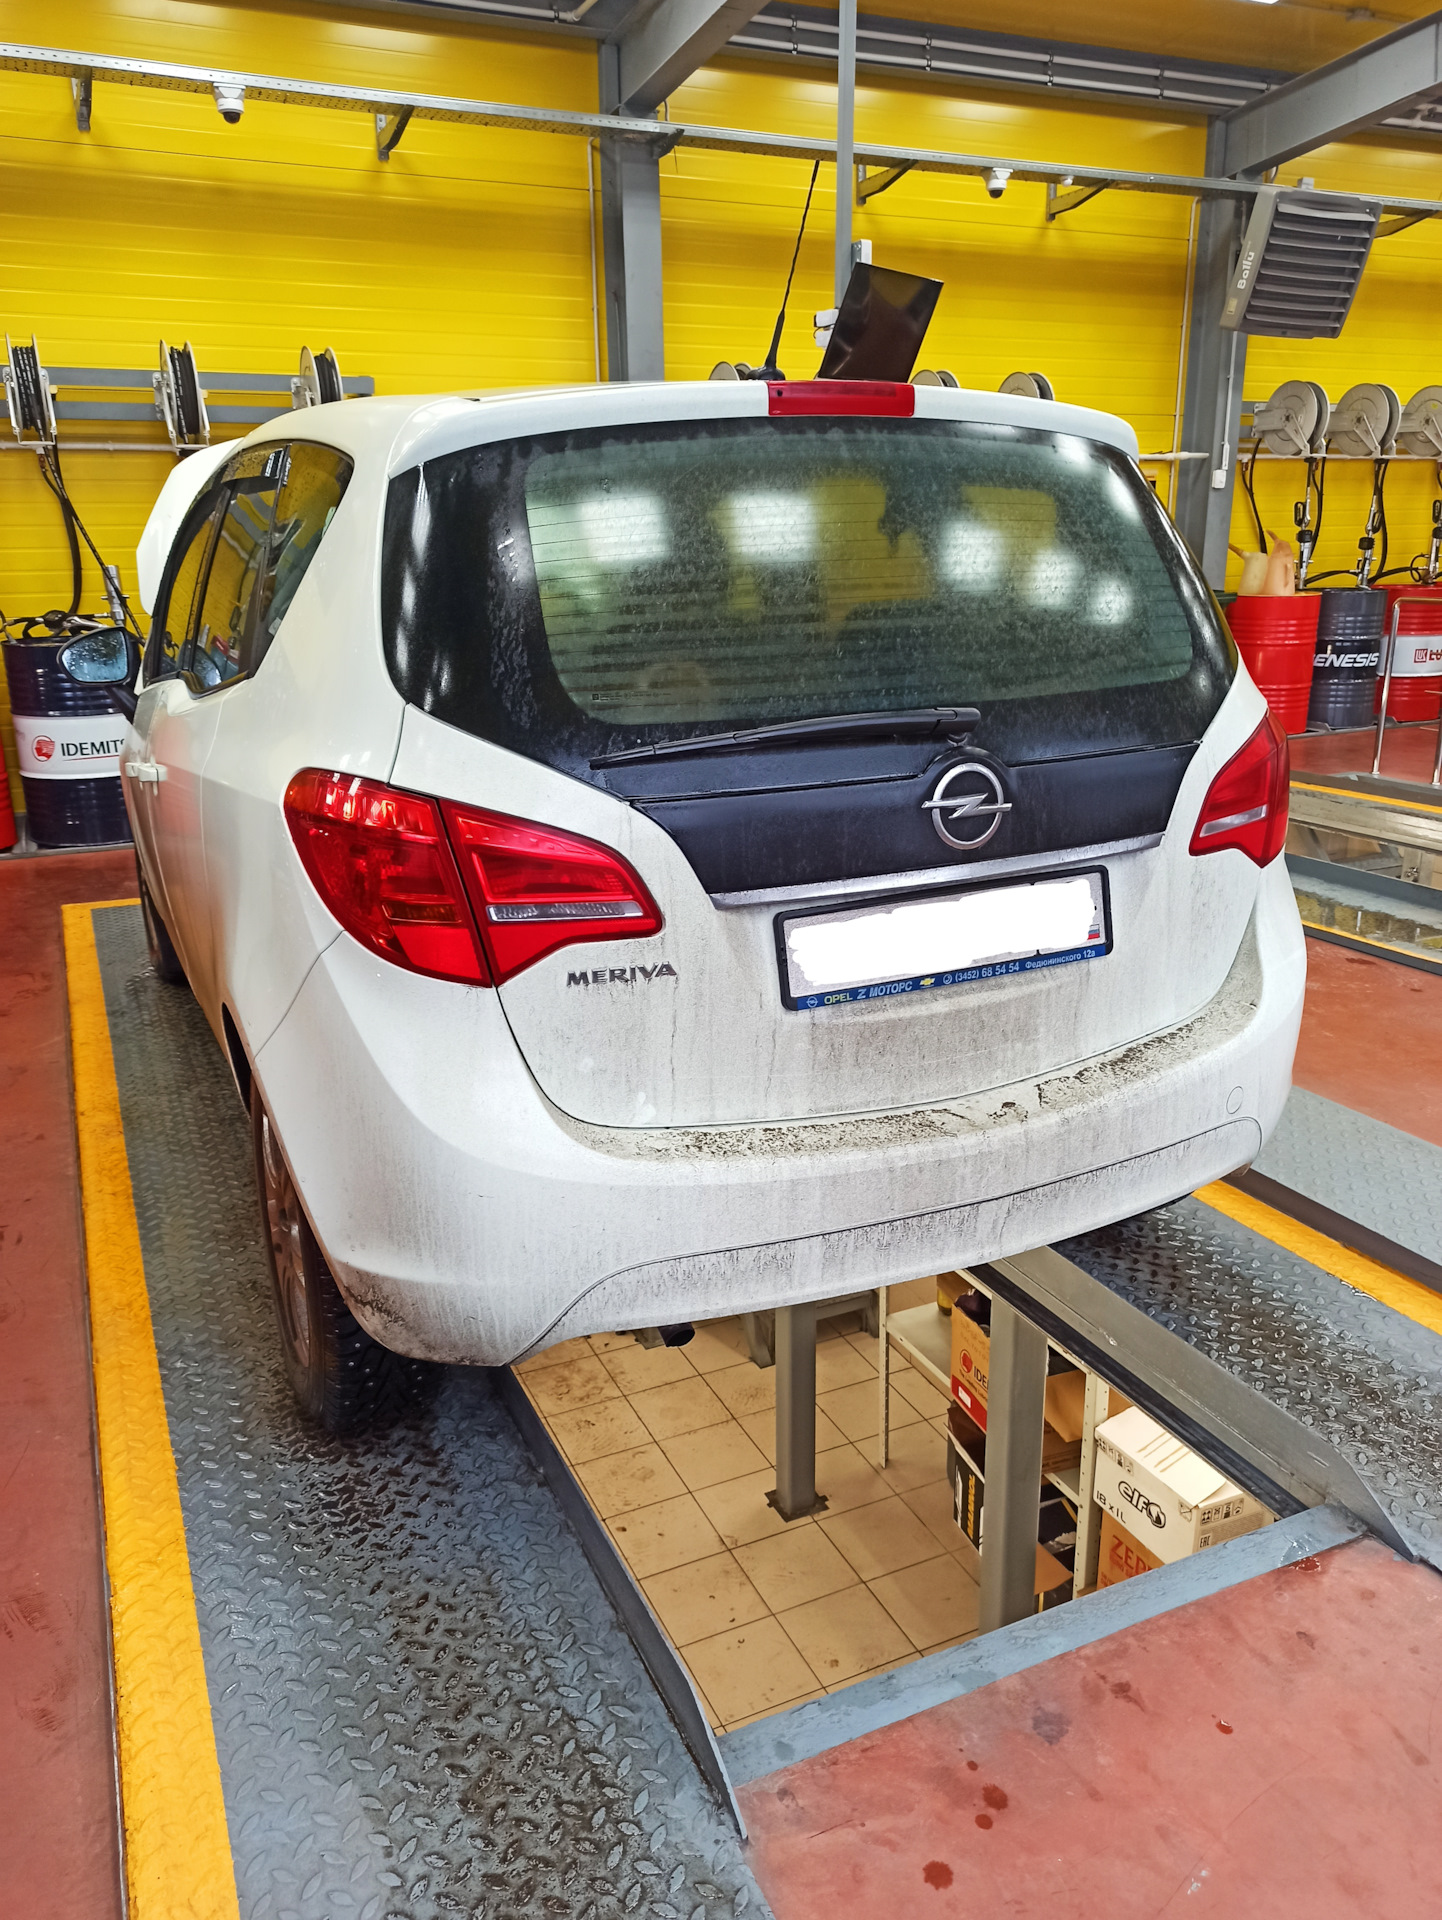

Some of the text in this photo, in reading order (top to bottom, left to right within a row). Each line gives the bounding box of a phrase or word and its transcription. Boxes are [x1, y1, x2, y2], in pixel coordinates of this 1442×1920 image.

[1236, 251, 1255, 289] Ballu
[1313, 652, 1379, 667] ENESIS
[60, 738, 125, 757] IDEMIT
[566, 961, 677, 987] MERIVA
[823, 992, 853, 1005] OPEL
[856, 988, 867, 1000] Z
[869, 980, 913, 998] МОТОРС
[955, 970, 980, 982] (3452)
[981, 967, 993, 977] 68
[995, 964, 1006, 975] 54
[1008, 961, 1020, 973] 54
[1025, 953, 1081, 969] Федюнинского
[974, 1366, 989, 1390] IDE
[1096, 1490, 1107, 1505] 18
[1118, 1480, 1149, 1513] elf
[1109, 1534, 1152, 1574] ZEP
